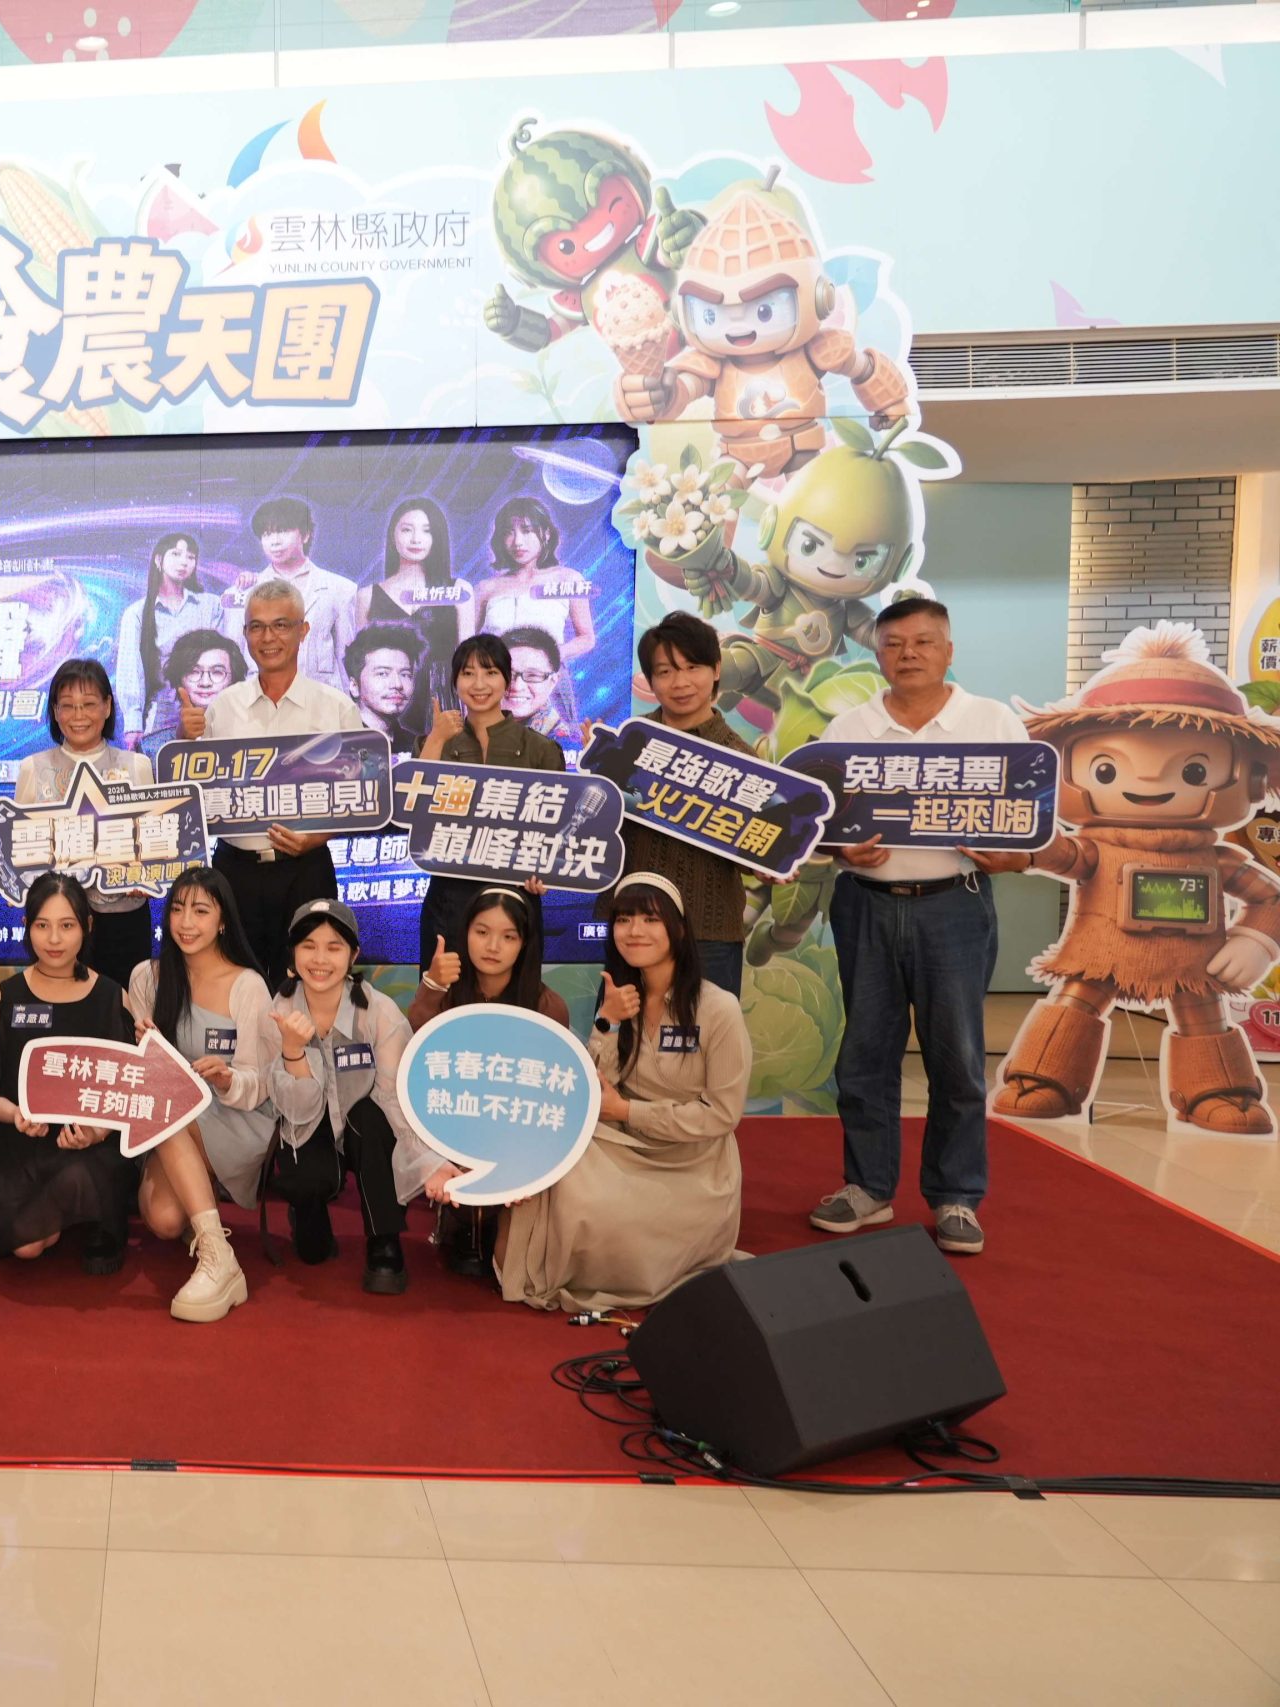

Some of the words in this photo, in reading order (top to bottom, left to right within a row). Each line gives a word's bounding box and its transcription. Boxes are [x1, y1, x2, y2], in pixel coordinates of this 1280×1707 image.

[270, 208, 470, 252] 雲林縣政府
[269, 262, 318, 274] YUNLIN
[320, 259, 375, 272] COUNTY
[379, 256, 473, 270] GOVERNMENT
[1260, 638, 1280, 654] 薪
[1260, 655, 1280, 671] 價
[171, 747, 278, 782] 10.17
[633, 738, 779, 813] 最強歌聲
[842, 755, 1005, 793] 免費索票
[107, 786, 125, 795] 2026
[394, 770, 569, 824] 十強集結
[636, 781, 783, 858] 火力全開
[871, 795, 1037, 837] 一起來嗨
[1256, 826, 1280, 843] 專
[10, 812, 181, 867] 雲耀星聲
[422, 821, 609, 881] 巔峰對決
[1179, 878, 1197, 893] 73
[41, 1051, 147, 1089] 雲林青年
[424, 1050, 579, 1098] 青春在雲林
[425, 1088, 568, 1132] 熱血不打烊
